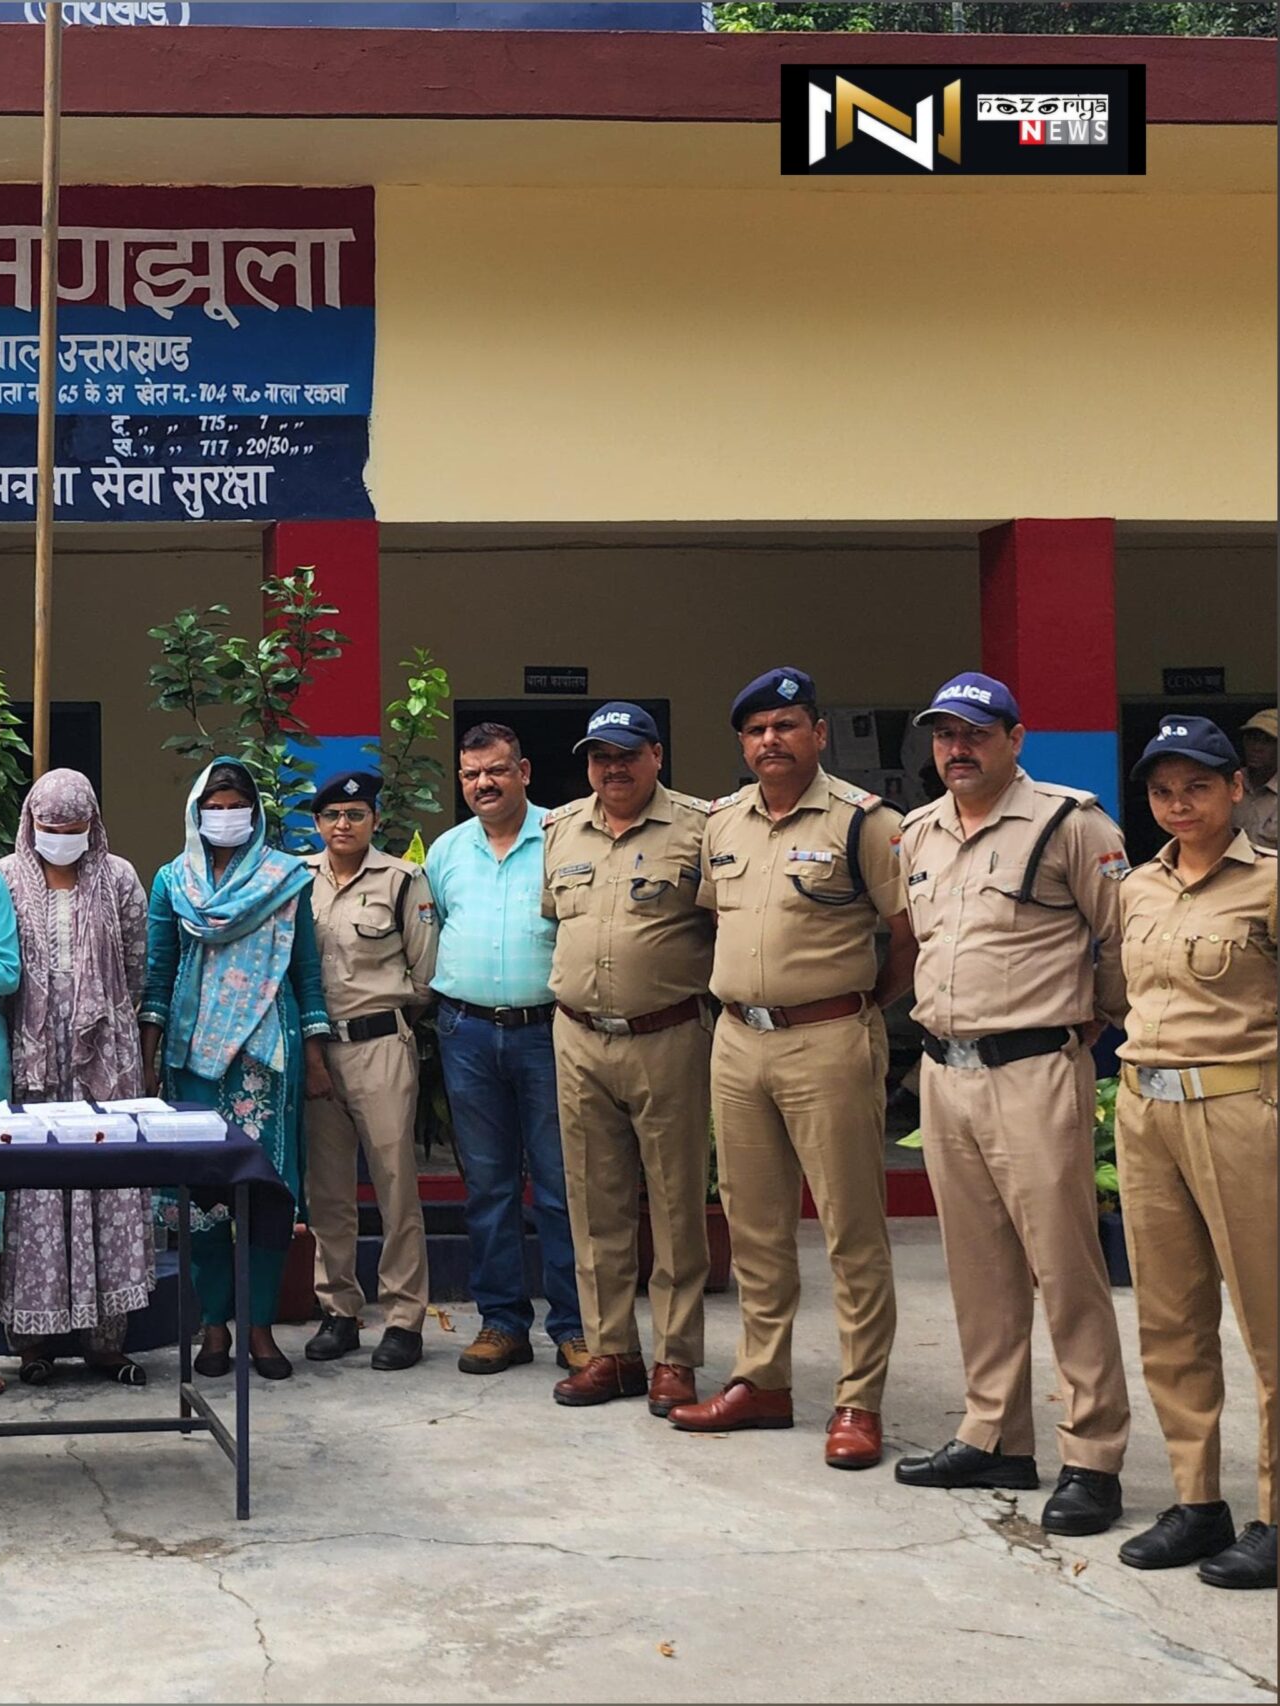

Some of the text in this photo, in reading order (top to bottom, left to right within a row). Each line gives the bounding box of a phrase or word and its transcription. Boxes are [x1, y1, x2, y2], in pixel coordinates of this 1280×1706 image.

[58, 335, 192, 374] उत्तराखण्ड
[84, 378, 100, 405] के
[134, 377, 170, 407] खेत
[265, 383, 301, 405] नाला
[303, 384, 350, 405] रकवा
[91, 456, 166, 509] सेवा
[172, 464, 276, 520] सुरक्षा
[934, 684, 992, 705] POLICE
[587, 711, 632, 735] POLICE
